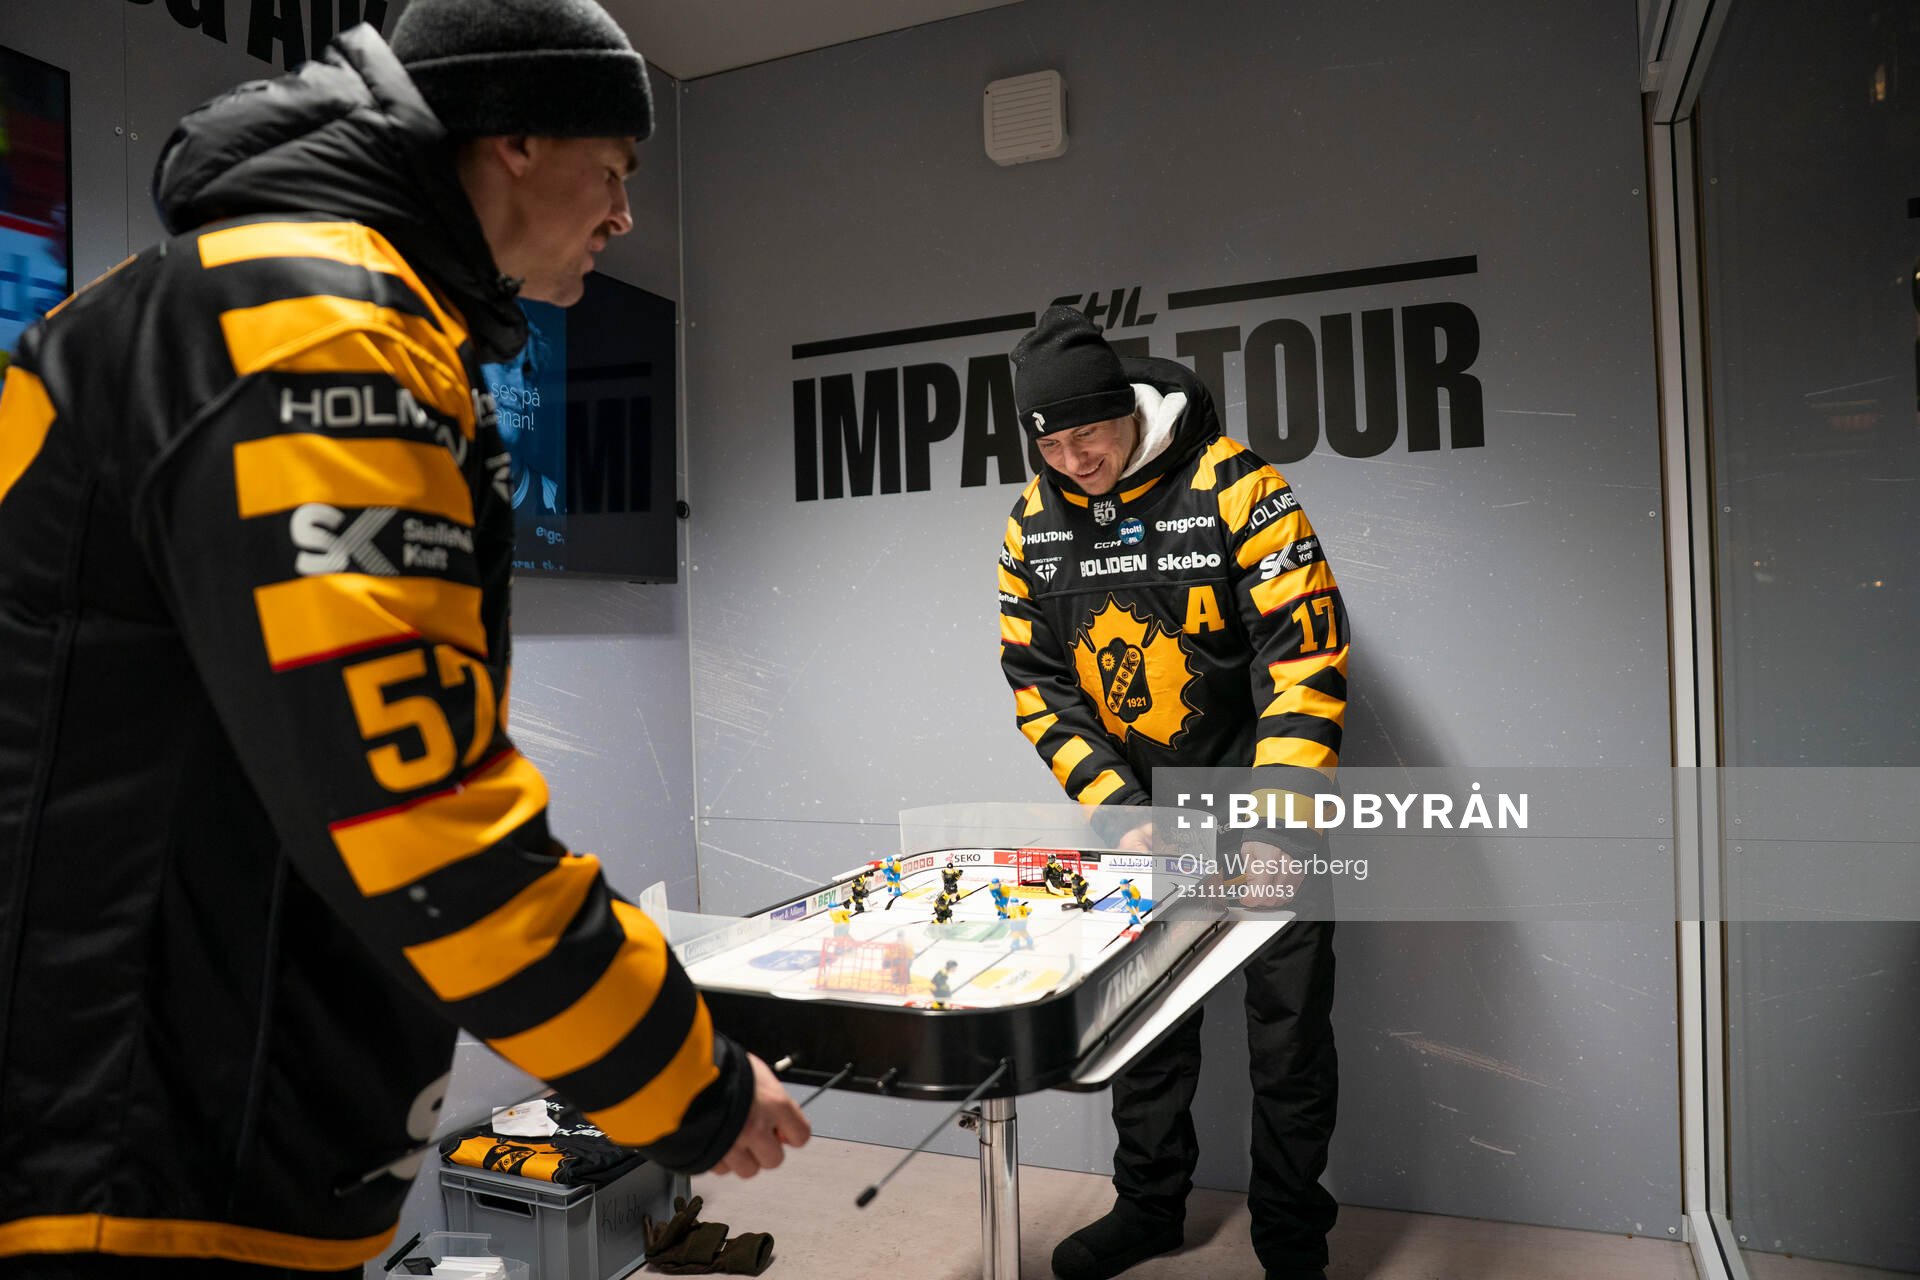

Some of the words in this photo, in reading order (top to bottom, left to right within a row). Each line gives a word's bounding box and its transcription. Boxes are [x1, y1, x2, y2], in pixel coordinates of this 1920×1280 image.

[1176, 301, 1486, 466] TOUR
[522, 387, 541, 409] på
[1094, 508, 1116, 522] 50
[1094, 540, 1122, 550] CCM
[1157, 551, 1221, 571] skebo
[1182, 585, 1225, 634] A
[1291, 596, 1337, 654] 17
[1126, 696, 1147, 709] 1921
[343, 644, 497, 793] 57
[954, 853, 981, 863] SEKO
